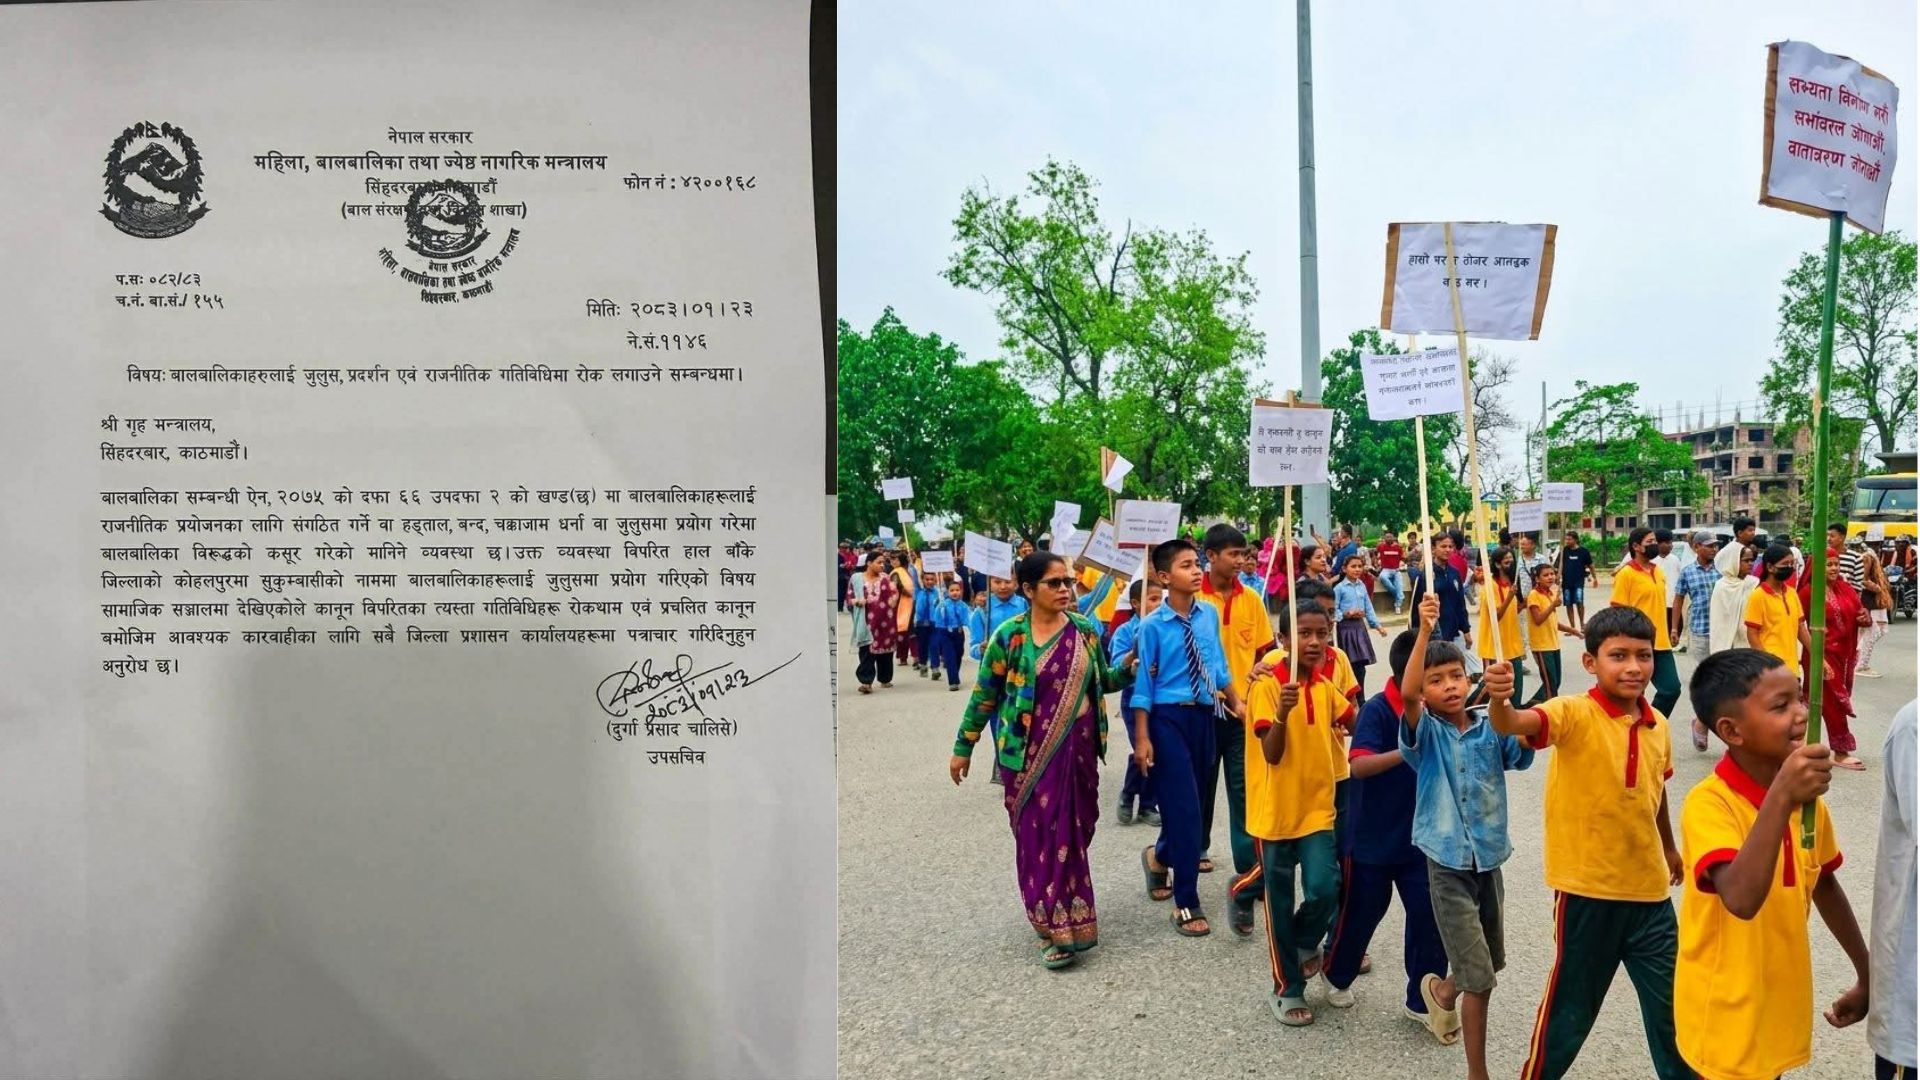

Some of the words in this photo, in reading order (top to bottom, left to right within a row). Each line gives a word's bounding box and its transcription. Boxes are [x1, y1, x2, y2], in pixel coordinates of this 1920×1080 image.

[388, 127, 423, 144] नेपाल
[428, 131, 473, 144] सरकार
[254, 150, 309, 174] महिला,
[315, 150, 404, 170] बालबालिका
[409, 153, 439, 169] तथा
[444, 150, 476, 170] ज्येष्ठ
[481, 150, 539, 170] नागरिक
[544, 153, 608, 170] मन्त्रालय
[623, 173, 652, 189] फोन
[680, 176, 756, 191] ४२००१६८
[342, 202, 371, 219] (बाल
[490, 202, 527, 219] शाखा)
[194, 294, 224, 309] १५५
[348, 364, 390, 384] प्रदर्शन
[396, 365, 418, 384] एवं
[424, 364, 492, 382] राजनीतिक
[499, 364, 569, 382] गतिविधिमा
[575, 364, 604, 382] रोक
[610, 363, 662, 381] लगाउने
[101, 415, 119, 431] श्री
[125, 418, 147, 437] गृह
[153, 418, 216, 434] मन्त्रालय,
[100, 442, 171, 461] सिंहदरबार,
[100, 487, 179, 504] बालबालिका
[185, 487, 240, 504] सम्बन्धी
[246, 486, 271, 507] ऐन,
[278, 490, 324, 505] २०७५
[332, 486, 353, 504] को
[360, 491, 390, 504] दफा
[400, 490, 420, 505] ६६
[430, 490, 481, 504] उपदफा
[490, 490, 499, 504] २
[509, 485, 529, 503] को
[536, 488, 596, 506] खण्ड(छ)
[604, 490, 621, 503] मा
[628, 485, 757, 504] बालबालिकाहरूलाई
[100, 515, 169, 533] राजनीतिक
[176, 514, 243, 532] प्रयोजनका
[250, 514, 284, 532] लागि
[291, 514, 341, 532] संगठित
[348, 513, 371, 531] गर्ने
[378, 519, 394, 531] वा
[457, 518, 489, 534] बन्द,
[559, 513, 585, 531] धर्ना
[592, 518, 608, 531] वा
[615, 518, 667, 536] जुलुसमा
[675, 513, 712, 531] प्रयोग
[720, 513, 756, 531] गरेमा
[100, 543, 179, 560] बालबालिका
[265, 547, 302, 564] कसूर
[314, 542, 354, 560] गरेको
[367, 542, 408, 560] मानिने
[420, 547, 474, 559] व्यवस्था
[557, 546, 611, 559] व्यवस्था
[624, 541, 670, 559] विपरित
[683, 546, 711, 559] हाल
[724, 541, 756, 559] बाँके
[101, 570, 162, 588] जिल्लाको
[173, 570, 249, 593] कोहलपुरमा
[259, 570, 344, 593] सुकुम्बासीको
[355, 574, 397, 588] नाममा
[407, 569, 535, 588] बालबालिकाहरूलाई
[545, 574, 599, 592] जुलुसमा
[610, 569, 647, 587] प्रयोग
[657, 568, 709, 589] गरिएको
[720, 568, 756, 586] विषय
[101, 599, 164, 617] सामाजिक
[236, 598, 307, 619] देखिएकोले
[314, 603, 355, 620] कानून
[362, 598, 427, 616] विपरितका
[434, 602, 475, 616] त्यस्ता
[482, 597, 561, 616] गतिविधिहरू
[568, 597, 623, 615] रोकथाम
[630, 598, 652, 617] एवं
[659, 597, 708, 614] प्रचलित
[715, 601, 756, 619] कानून
[101, 627, 156, 645] बमोजिम
[169, 631, 230, 645] आवश्यक
[242, 627, 317, 645] कारवाहीका
[328, 626, 360, 643] लागि
[372, 624, 395, 643] सबै
[406, 625, 449, 643] जिल्ला
[460, 629, 509, 643] प्रशासन
[520, 625, 616, 643] कार्यालयहरूमा
[627, 629, 678, 643] पत्राचार
[688, 625, 756, 647] गरिदिनुहुन
[102, 655, 149, 678] अनुरोध
[155, 658, 178, 676] छ।
[606, 718, 638, 741] (दुर्गा
[687, 718, 738, 737] चालिसे)
[646, 746, 707, 765] उपसचिव
